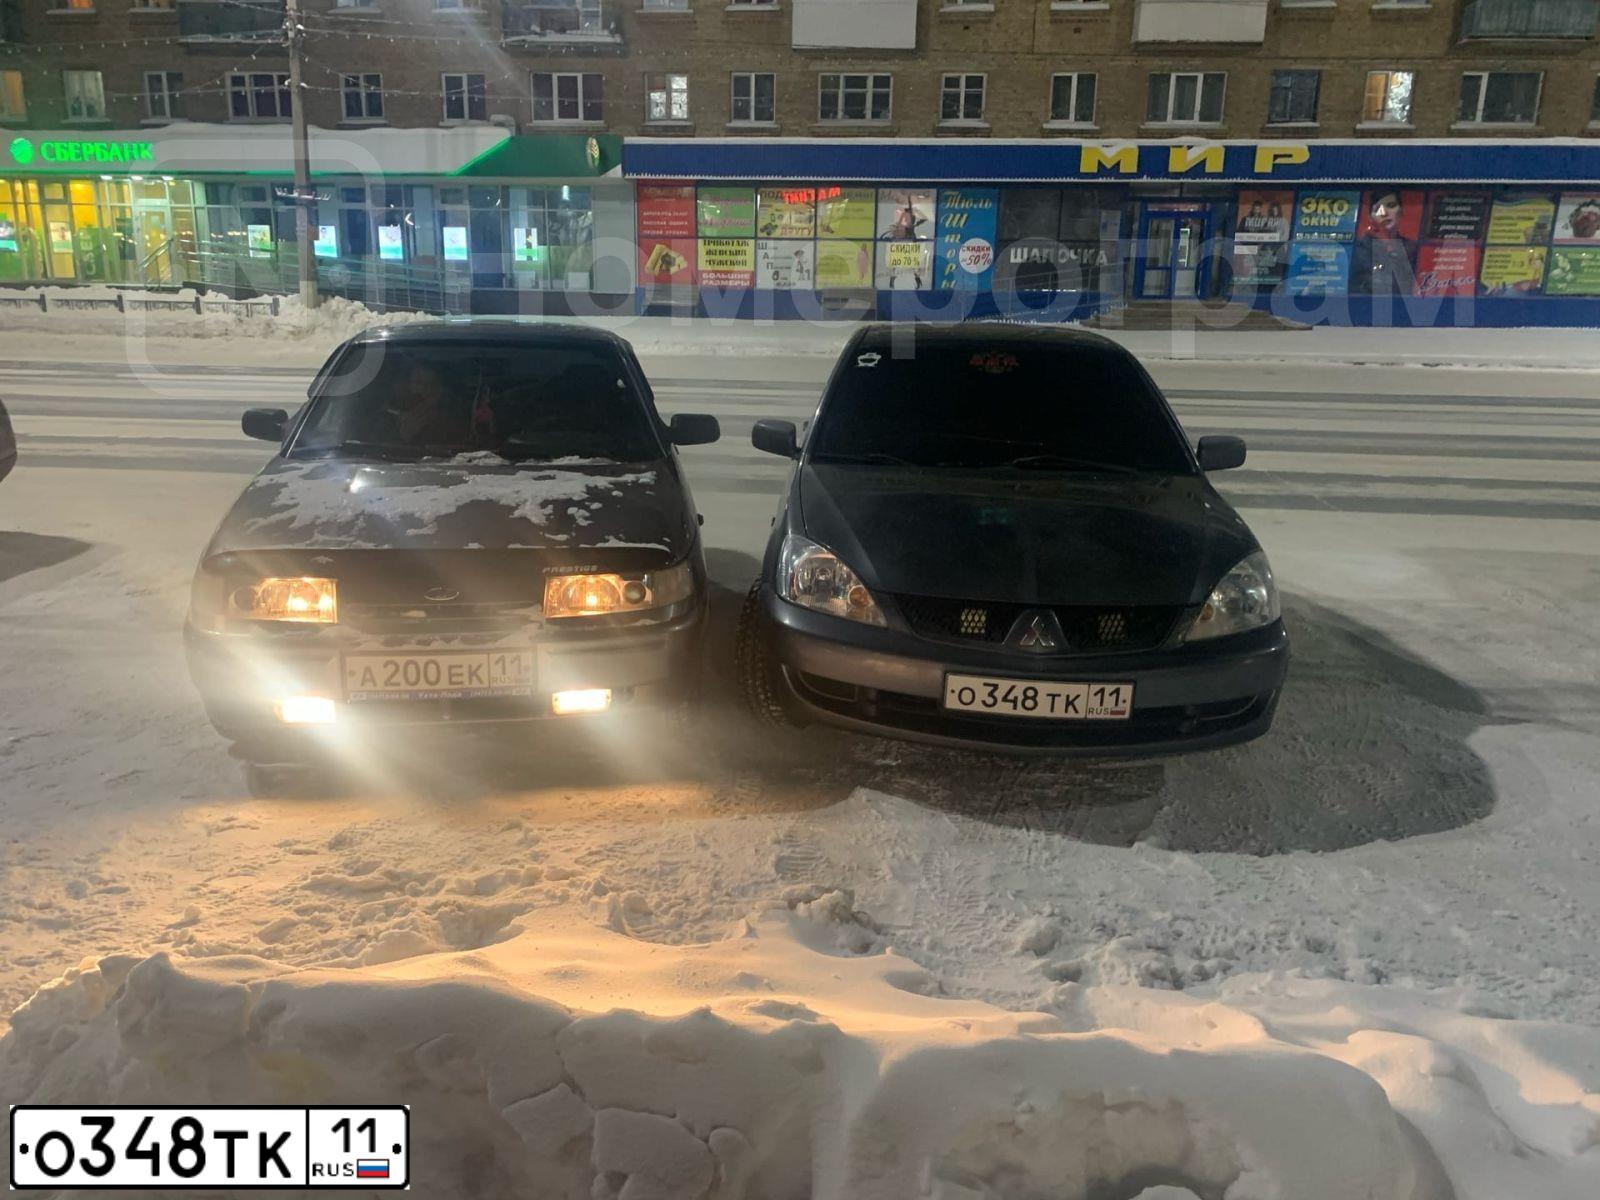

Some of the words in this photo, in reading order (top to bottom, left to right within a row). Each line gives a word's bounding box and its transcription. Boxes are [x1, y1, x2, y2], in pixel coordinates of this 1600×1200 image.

[41, 142, 153, 161] СБЕРБАНК
[1079, 145, 1311, 173] МИР
[1301, 197, 1349, 217] ЭКО
[890, 244, 921, 254] СКИДКИ
[961, 245, 992, 253] СКИДКИ
[1010, 247, 1109, 266] ШАПОЧКА
[360, 658, 484, 687] А200ЕК
[494, 654, 521, 676] 11
[957, 681, 1081, 715] О348ТК
[1093, 686, 1121, 707] 11
[1088, 707, 1109, 716] RUS
